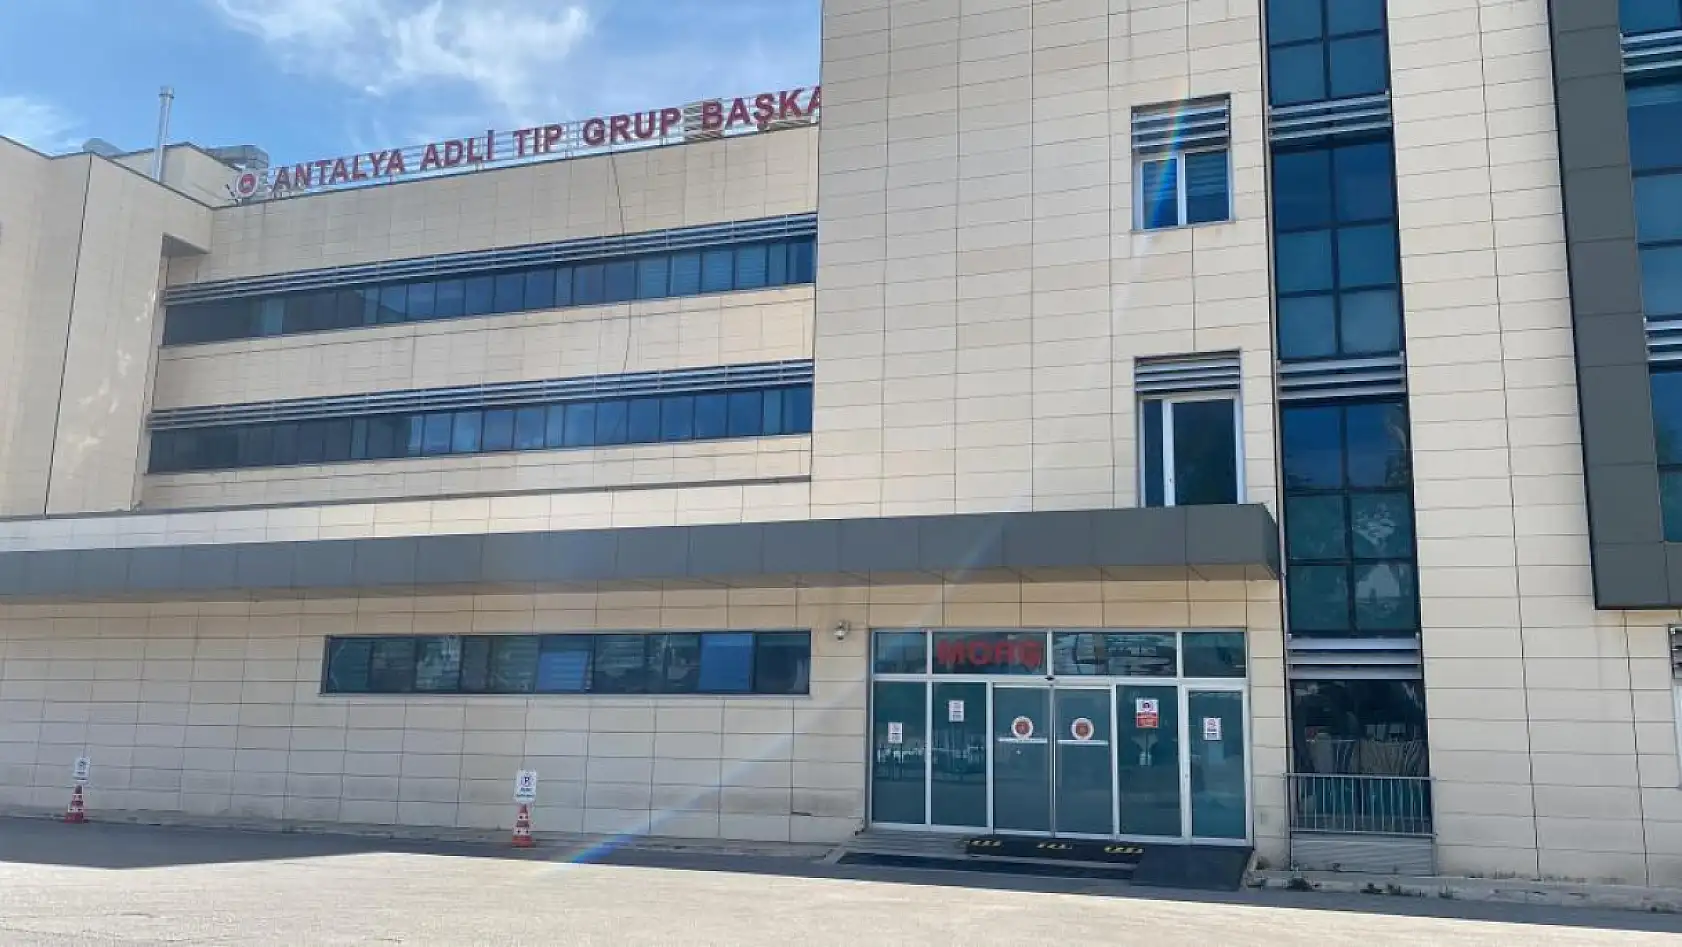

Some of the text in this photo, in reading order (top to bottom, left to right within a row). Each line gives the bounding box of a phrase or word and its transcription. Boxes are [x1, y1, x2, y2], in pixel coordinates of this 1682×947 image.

[272, 148, 405, 194] ANTALYA
[419, 130, 496, 171] ADLİ
[512, 123, 562, 157] TIP
[582, 107, 682, 147] GRUP
